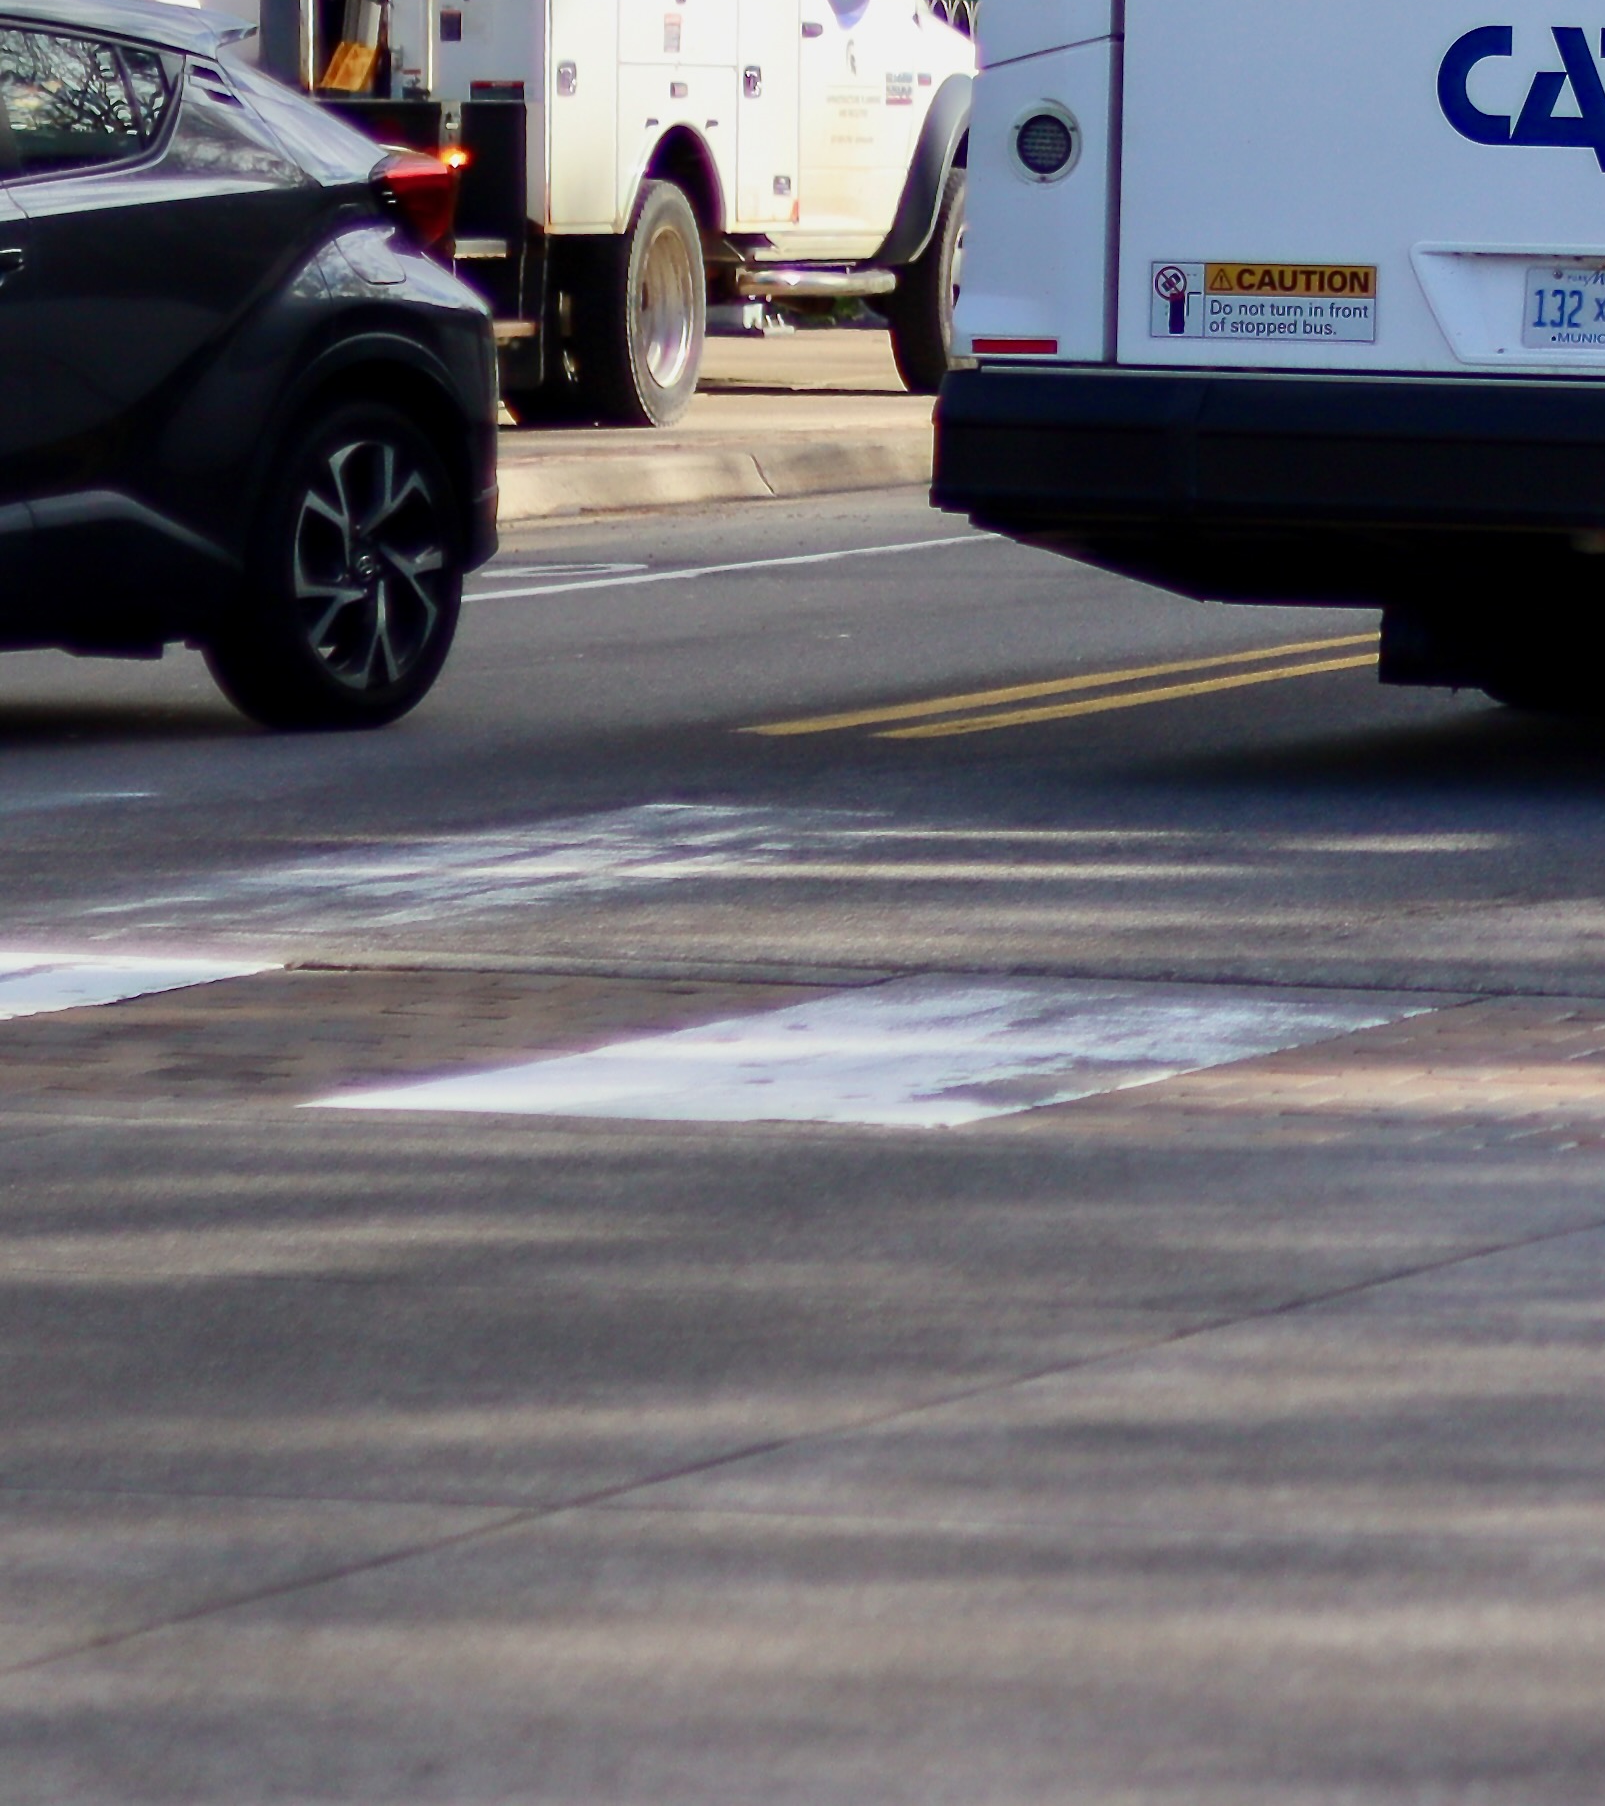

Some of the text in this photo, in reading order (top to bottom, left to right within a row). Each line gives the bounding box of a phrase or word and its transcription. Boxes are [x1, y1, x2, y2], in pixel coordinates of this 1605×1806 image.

[1235, 268, 1370, 293] CAUTION
[1209, 299, 1369, 319] Do not turn in front
[1532, 289, 1584, 328] 132
[1209, 317, 1338, 337] of stopped bus.
